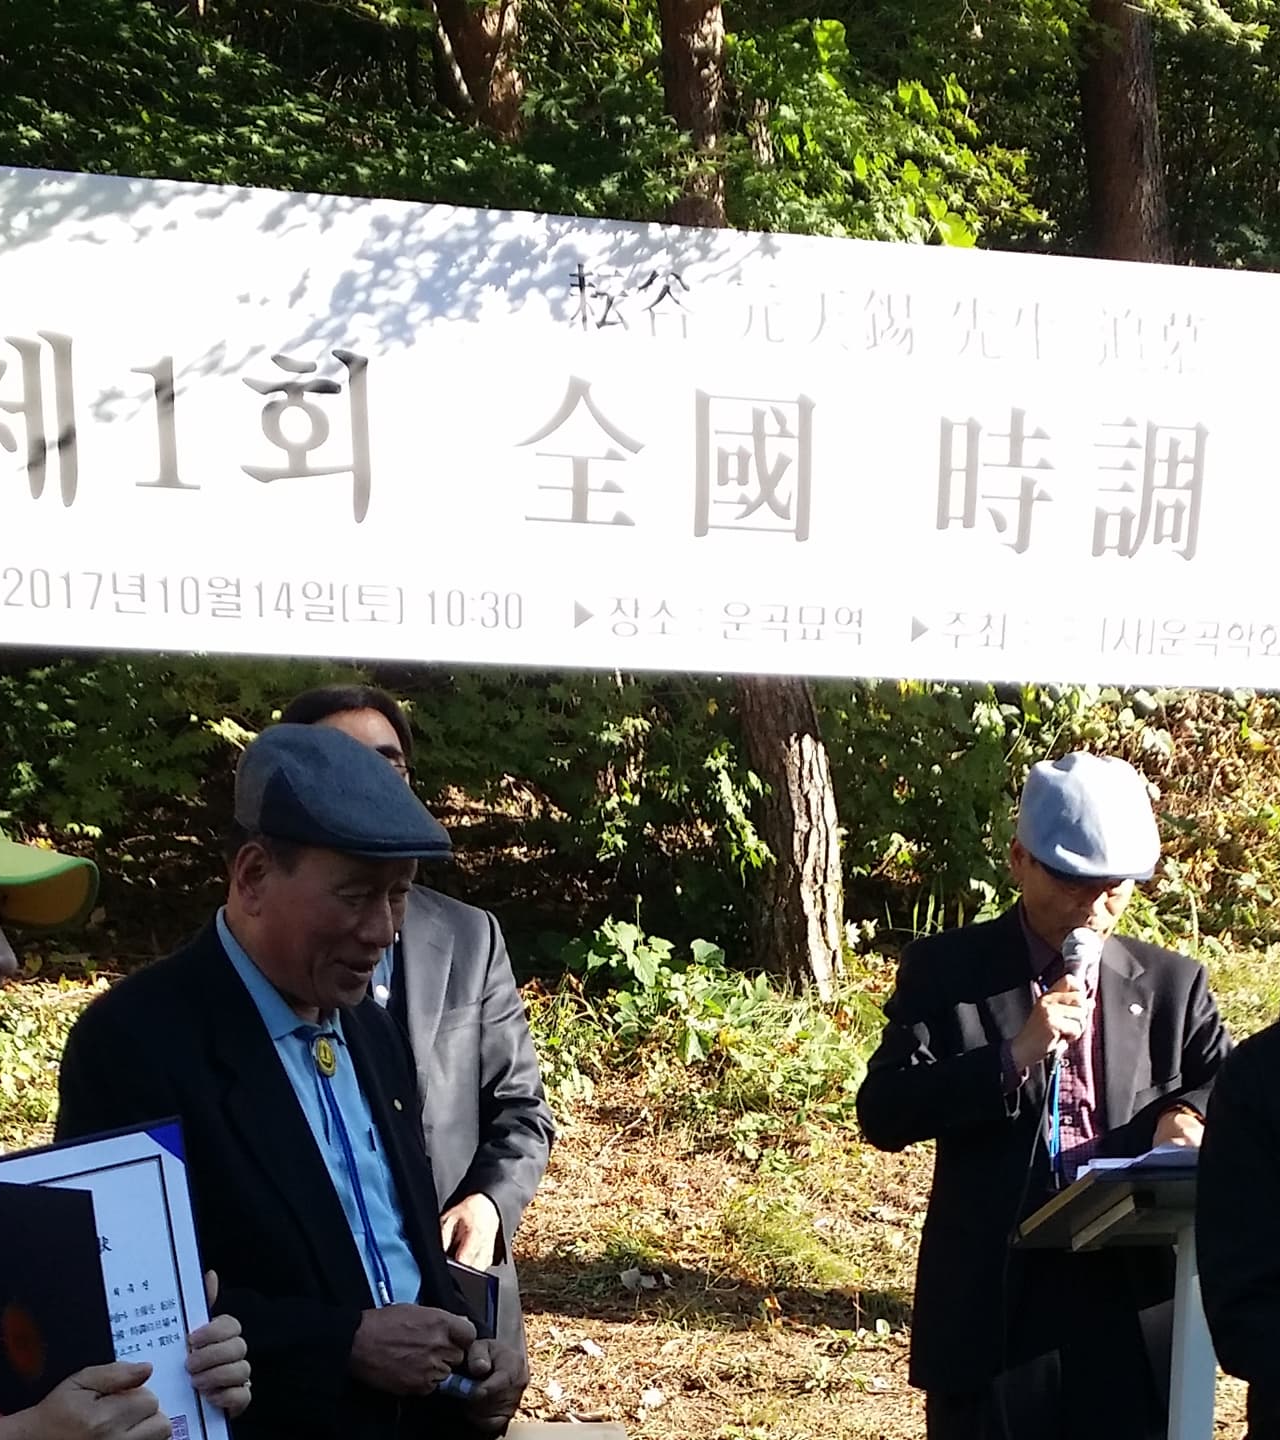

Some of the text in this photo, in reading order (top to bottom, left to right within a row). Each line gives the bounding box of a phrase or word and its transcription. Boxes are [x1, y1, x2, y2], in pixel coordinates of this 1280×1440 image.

[515, 375, 817, 543] 全國
[935, 407, 1211, 562] 時調
[427, 590, 524, 631] 10:30
[607, 596, 679, 640] 장소
[718, 601, 865, 648] 운곡묘역
